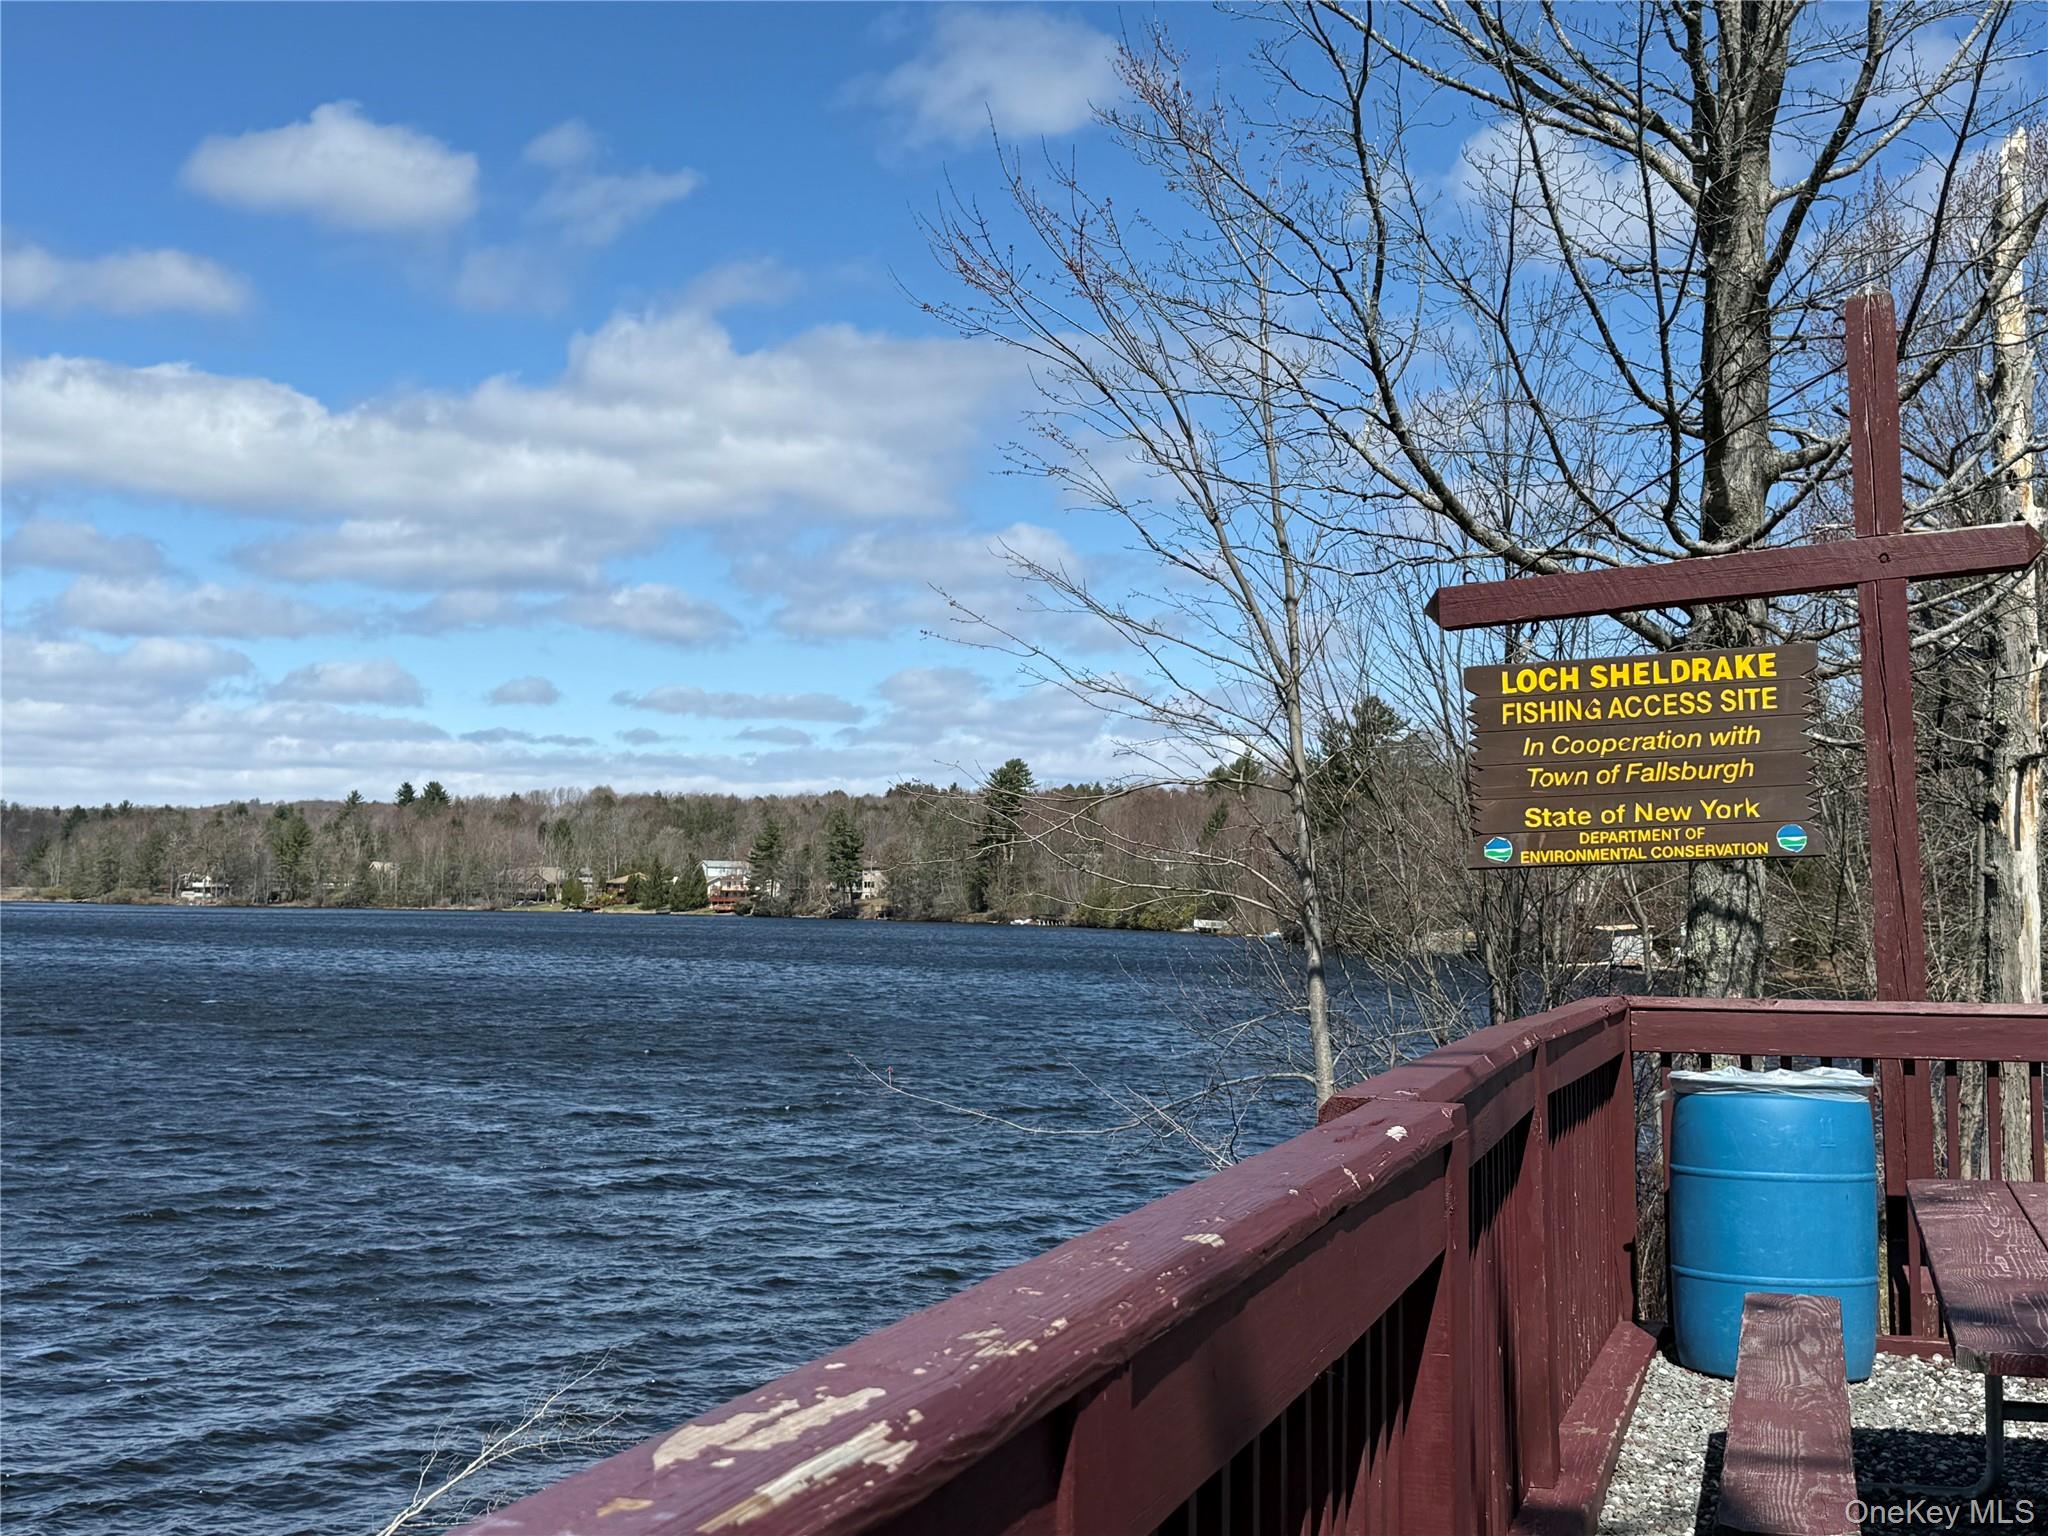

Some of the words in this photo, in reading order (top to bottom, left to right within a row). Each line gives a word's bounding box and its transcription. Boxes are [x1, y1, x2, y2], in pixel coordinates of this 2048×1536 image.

[1502, 667, 1579, 694] LOCH
[1590, 653, 1777, 690] SHELDRAKE
[1503, 699, 1602, 725] FISHING
[1608, 691, 1712, 719] ACCESS
[1720, 687, 1778, 712] SITE
[1523, 738, 1544, 756] In
[1552, 731, 1702, 757] Cooperation
[1710, 726, 1760, 746] with
[1528, 768, 1588, 787] Town
[1596, 764, 1621, 784] of
[1626, 758, 1754, 783] Fallsburgh
[1525, 808, 1592, 827] State
[1601, 804, 1626, 824] of
[1635, 803, 1692, 822] New
[1700, 797, 1760, 820] York
[1579, 828, 1680, 844] DEPARTMENT
[1685, 827, 1705, 840] OF
[1521, 847, 1647, 864] ENVIRONMENTAL
[1651, 843, 1768, 859] CONSERVATION
